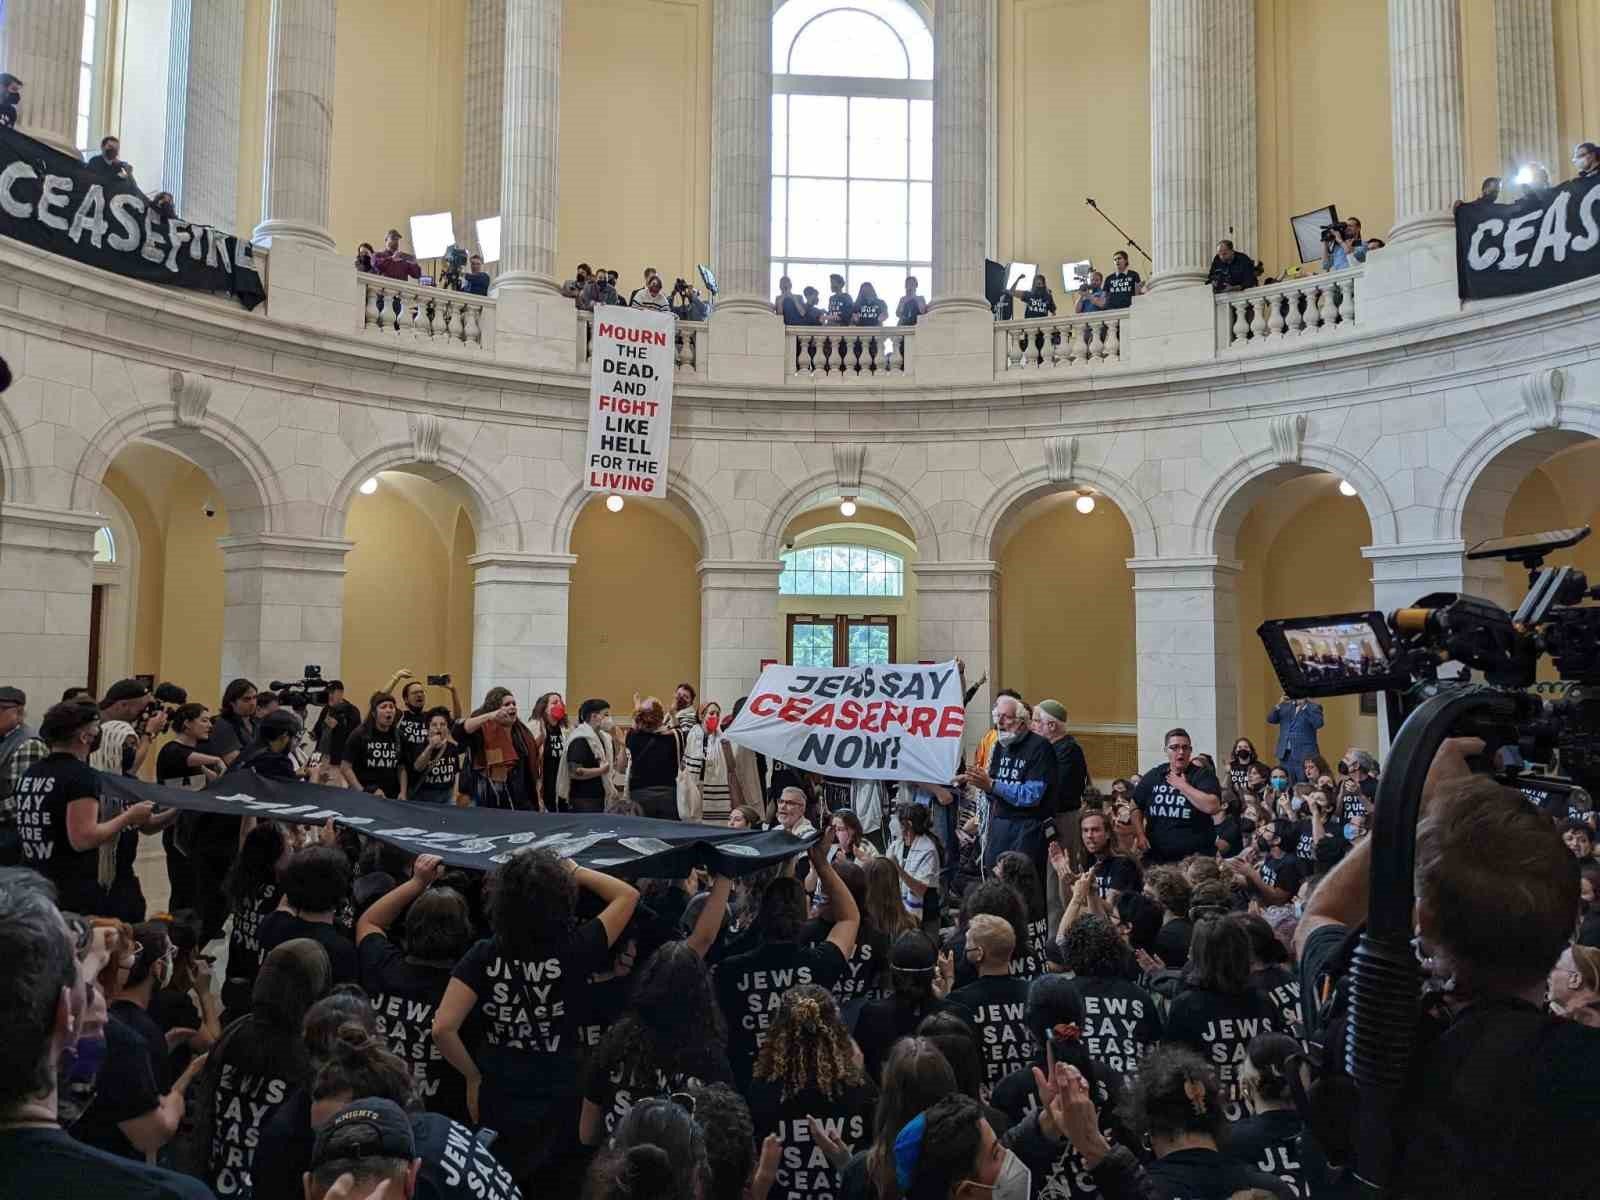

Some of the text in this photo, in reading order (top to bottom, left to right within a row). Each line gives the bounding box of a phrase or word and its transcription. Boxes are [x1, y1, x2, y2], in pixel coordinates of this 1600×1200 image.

[599, 322, 667, 347] MOURN
[616, 344, 648, 359] THE
[603, 359, 659, 381] DEAD,
[613, 380, 646, 396] AND
[599, 396, 658, 418] FIGHT
[606, 416, 649, 435] LIKE
[601, 435, 651, 456] HELL
[591, 454, 658, 474] FOR THE
[590, 472, 654, 493] LIVING
[788, 667, 953, 700] JEWS SAY
[367, 742, 388, 750] NOT
[373, 750, 397, 758] OUR
[798, 733, 902, 770] NOW!
[431, 765, 454, 776] OUR
[1155, 794, 1186, 806] OUR
[17, 811, 52, 825] EASE
[1150, 805, 1192, 819] NAME
[17, 826, 42, 841] IRE
[22, 841, 55, 860] OW
[1027, 918, 1047, 937] EWS
[736, 966, 813, 992] JEWS
[371, 992, 432, 1023] JEW
[747, 992, 782, 1013] SA
[1085, 996, 1144, 1019] EWS
[974, 1003, 1025, 1024] JEW
[1081, 1017, 1138, 1039] SAY
[1201, 1017, 1272, 1042] JEWS
[392, 1040, 442, 1060] ASE
[982, 1043, 1038, 1061] EAS
[1080, 1037, 1144, 1058] EASE
[1211, 1042, 1247, 1063] SA
[220, 1063, 288, 1104] EWS
[776, 1114, 864, 1142] JEWS
[784, 1144, 832, 1169] SA
